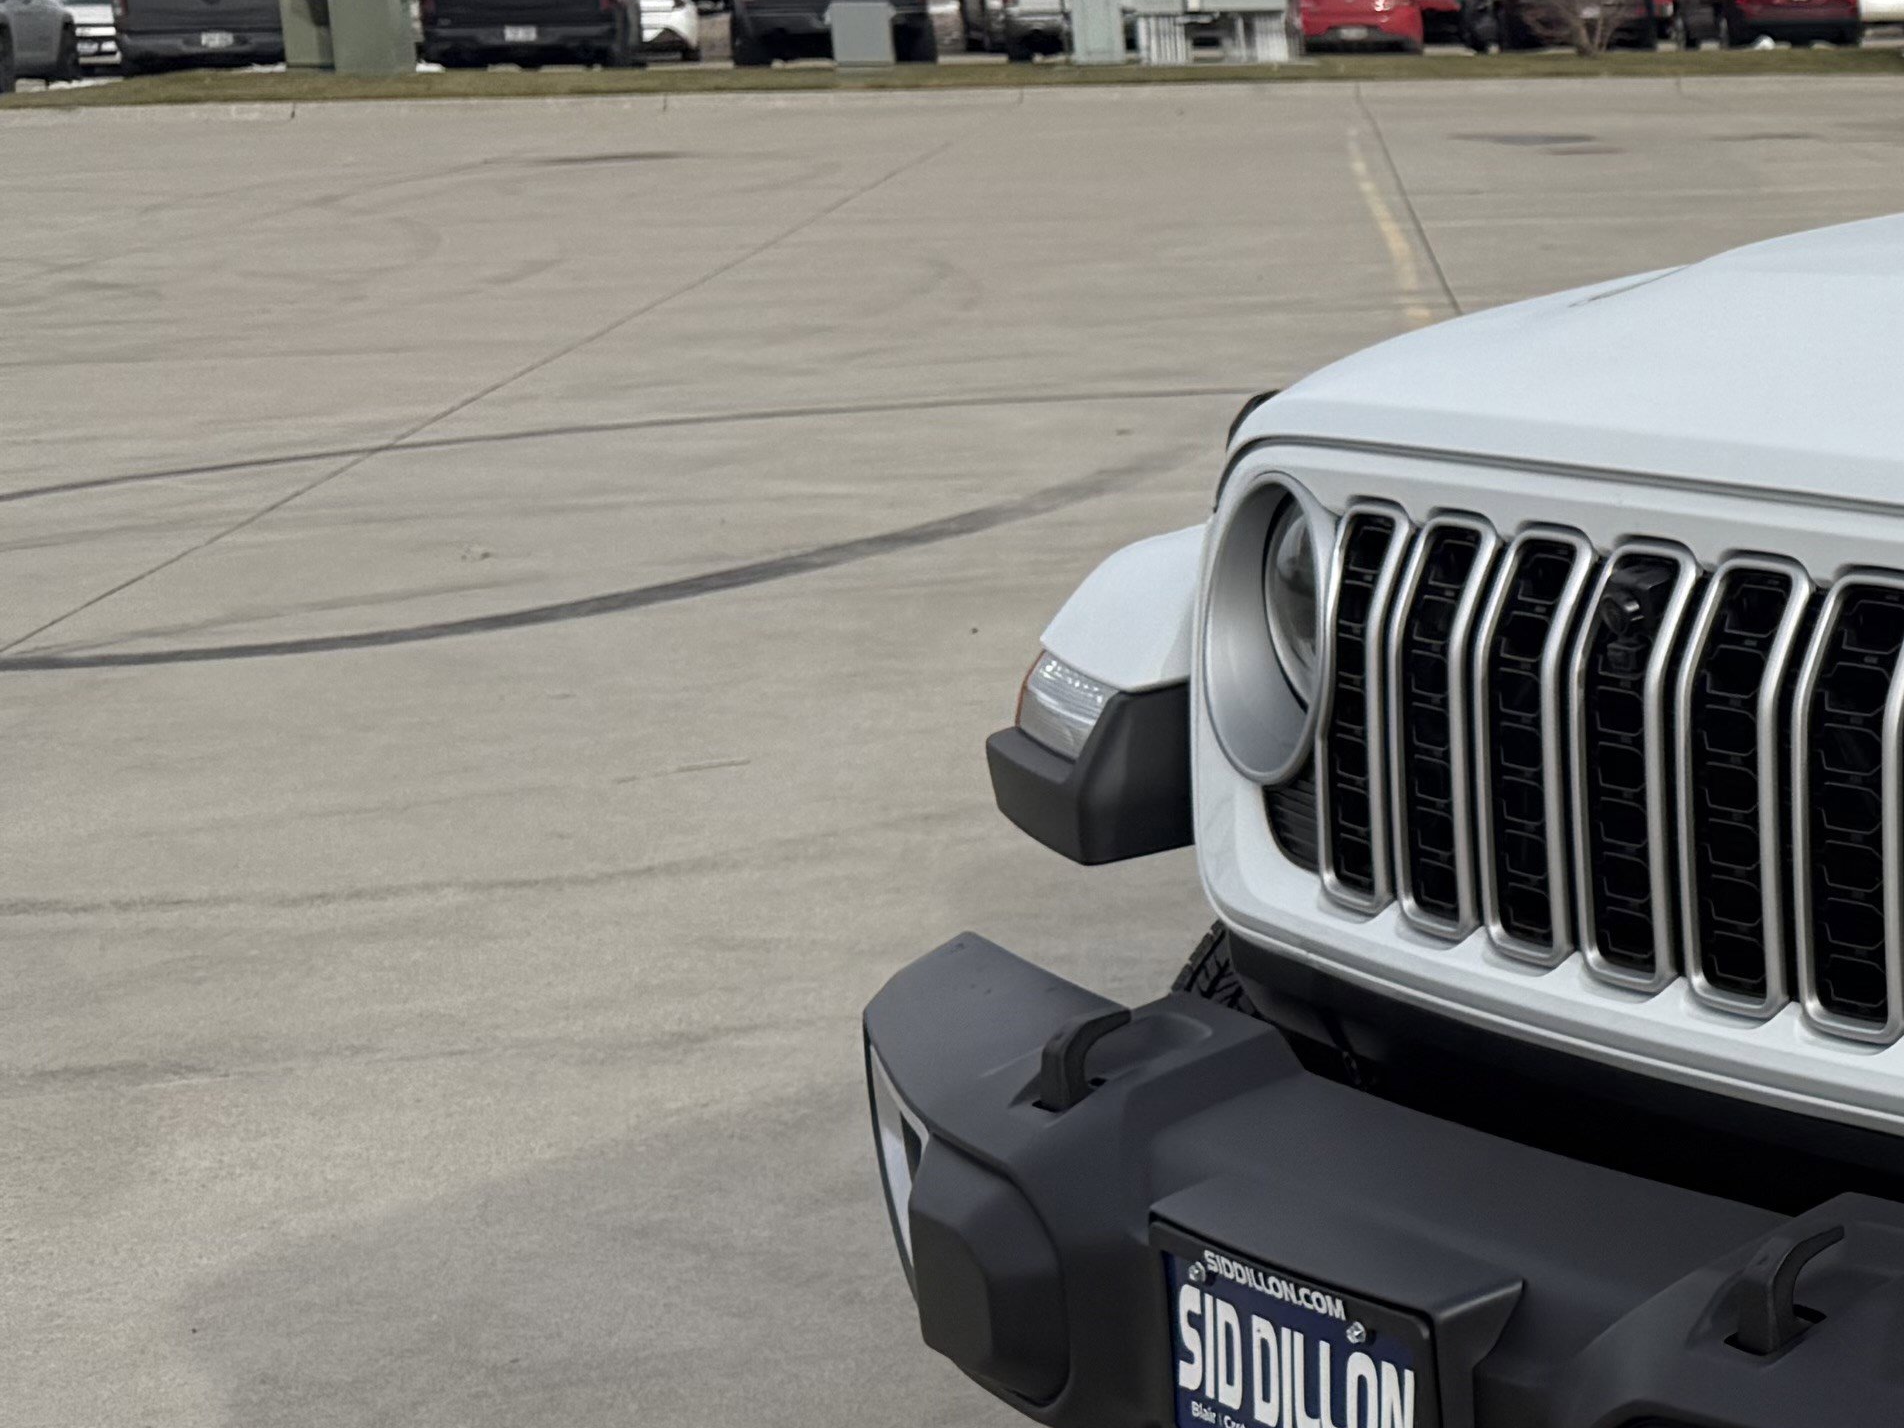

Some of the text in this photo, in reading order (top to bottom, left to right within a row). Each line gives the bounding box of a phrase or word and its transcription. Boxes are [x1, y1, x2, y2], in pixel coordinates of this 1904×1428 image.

[1203, 1249, 1347, 1321] SIDDILLON.COM
[1178, 1283, 1243, 1411] SID
[1190, 1400, 1217, 1425] Blair
